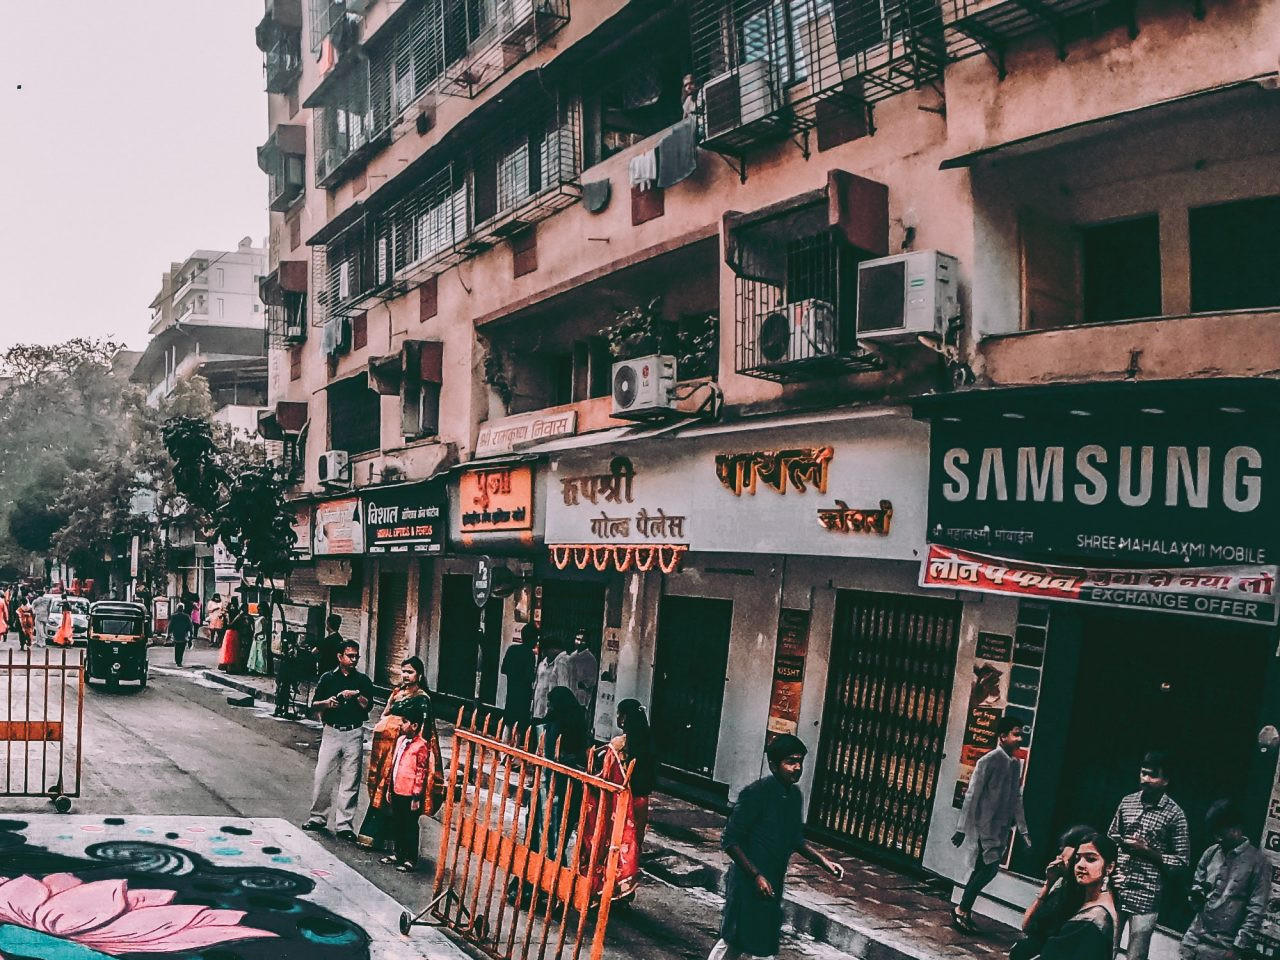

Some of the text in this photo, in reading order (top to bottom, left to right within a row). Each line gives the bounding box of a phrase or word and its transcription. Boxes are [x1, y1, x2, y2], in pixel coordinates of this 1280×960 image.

[531, 418, 568, 439] निवास
[942, 444, 1263, 512] SAMSUNG
[368, 502, 399, 525] विशाल
[1076, 534, 1266, 564] SHREE MAHALAXMI MOBILE
[1238, 571, 1275, 596] लो
[1091, 588, 1258, 618] EXCHANGE OFFER
